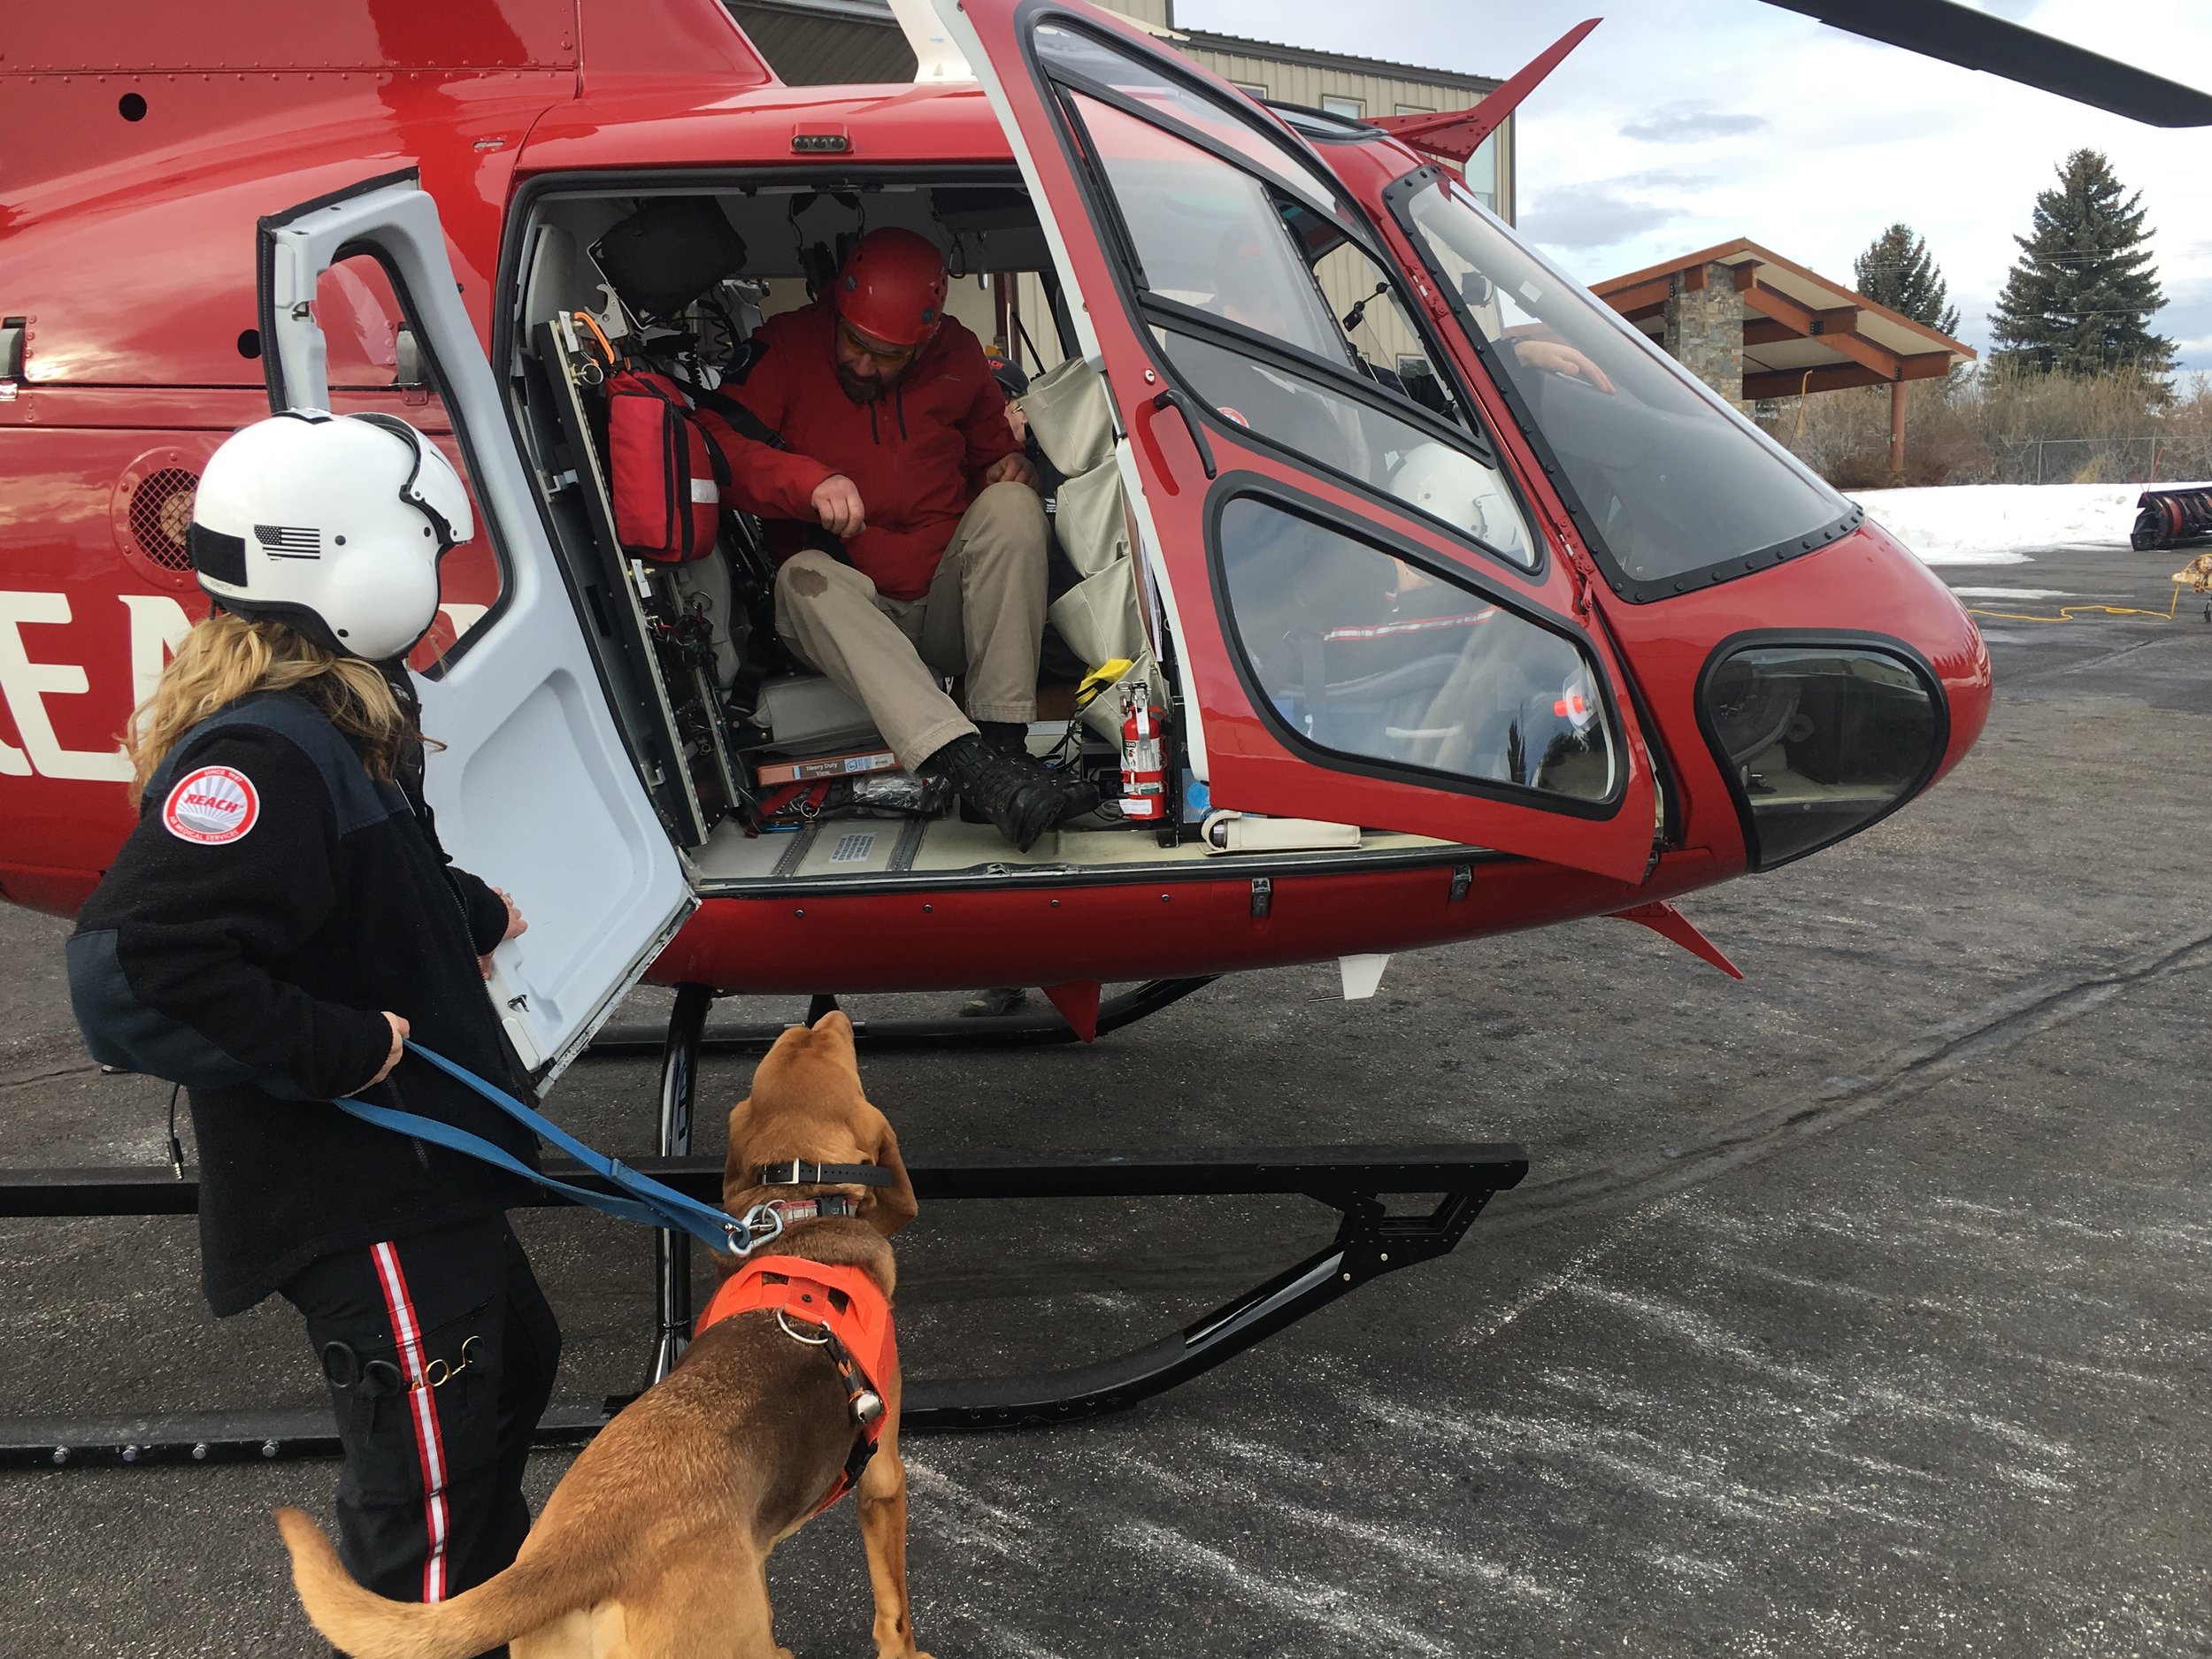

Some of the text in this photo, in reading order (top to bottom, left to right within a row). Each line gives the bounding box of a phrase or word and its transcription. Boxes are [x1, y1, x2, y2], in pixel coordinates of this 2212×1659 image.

[185, 794, 239, 813] REACH
[174, 823, 204, 840] MEDICAL
[205, 830, 239, 841] SERVICES
